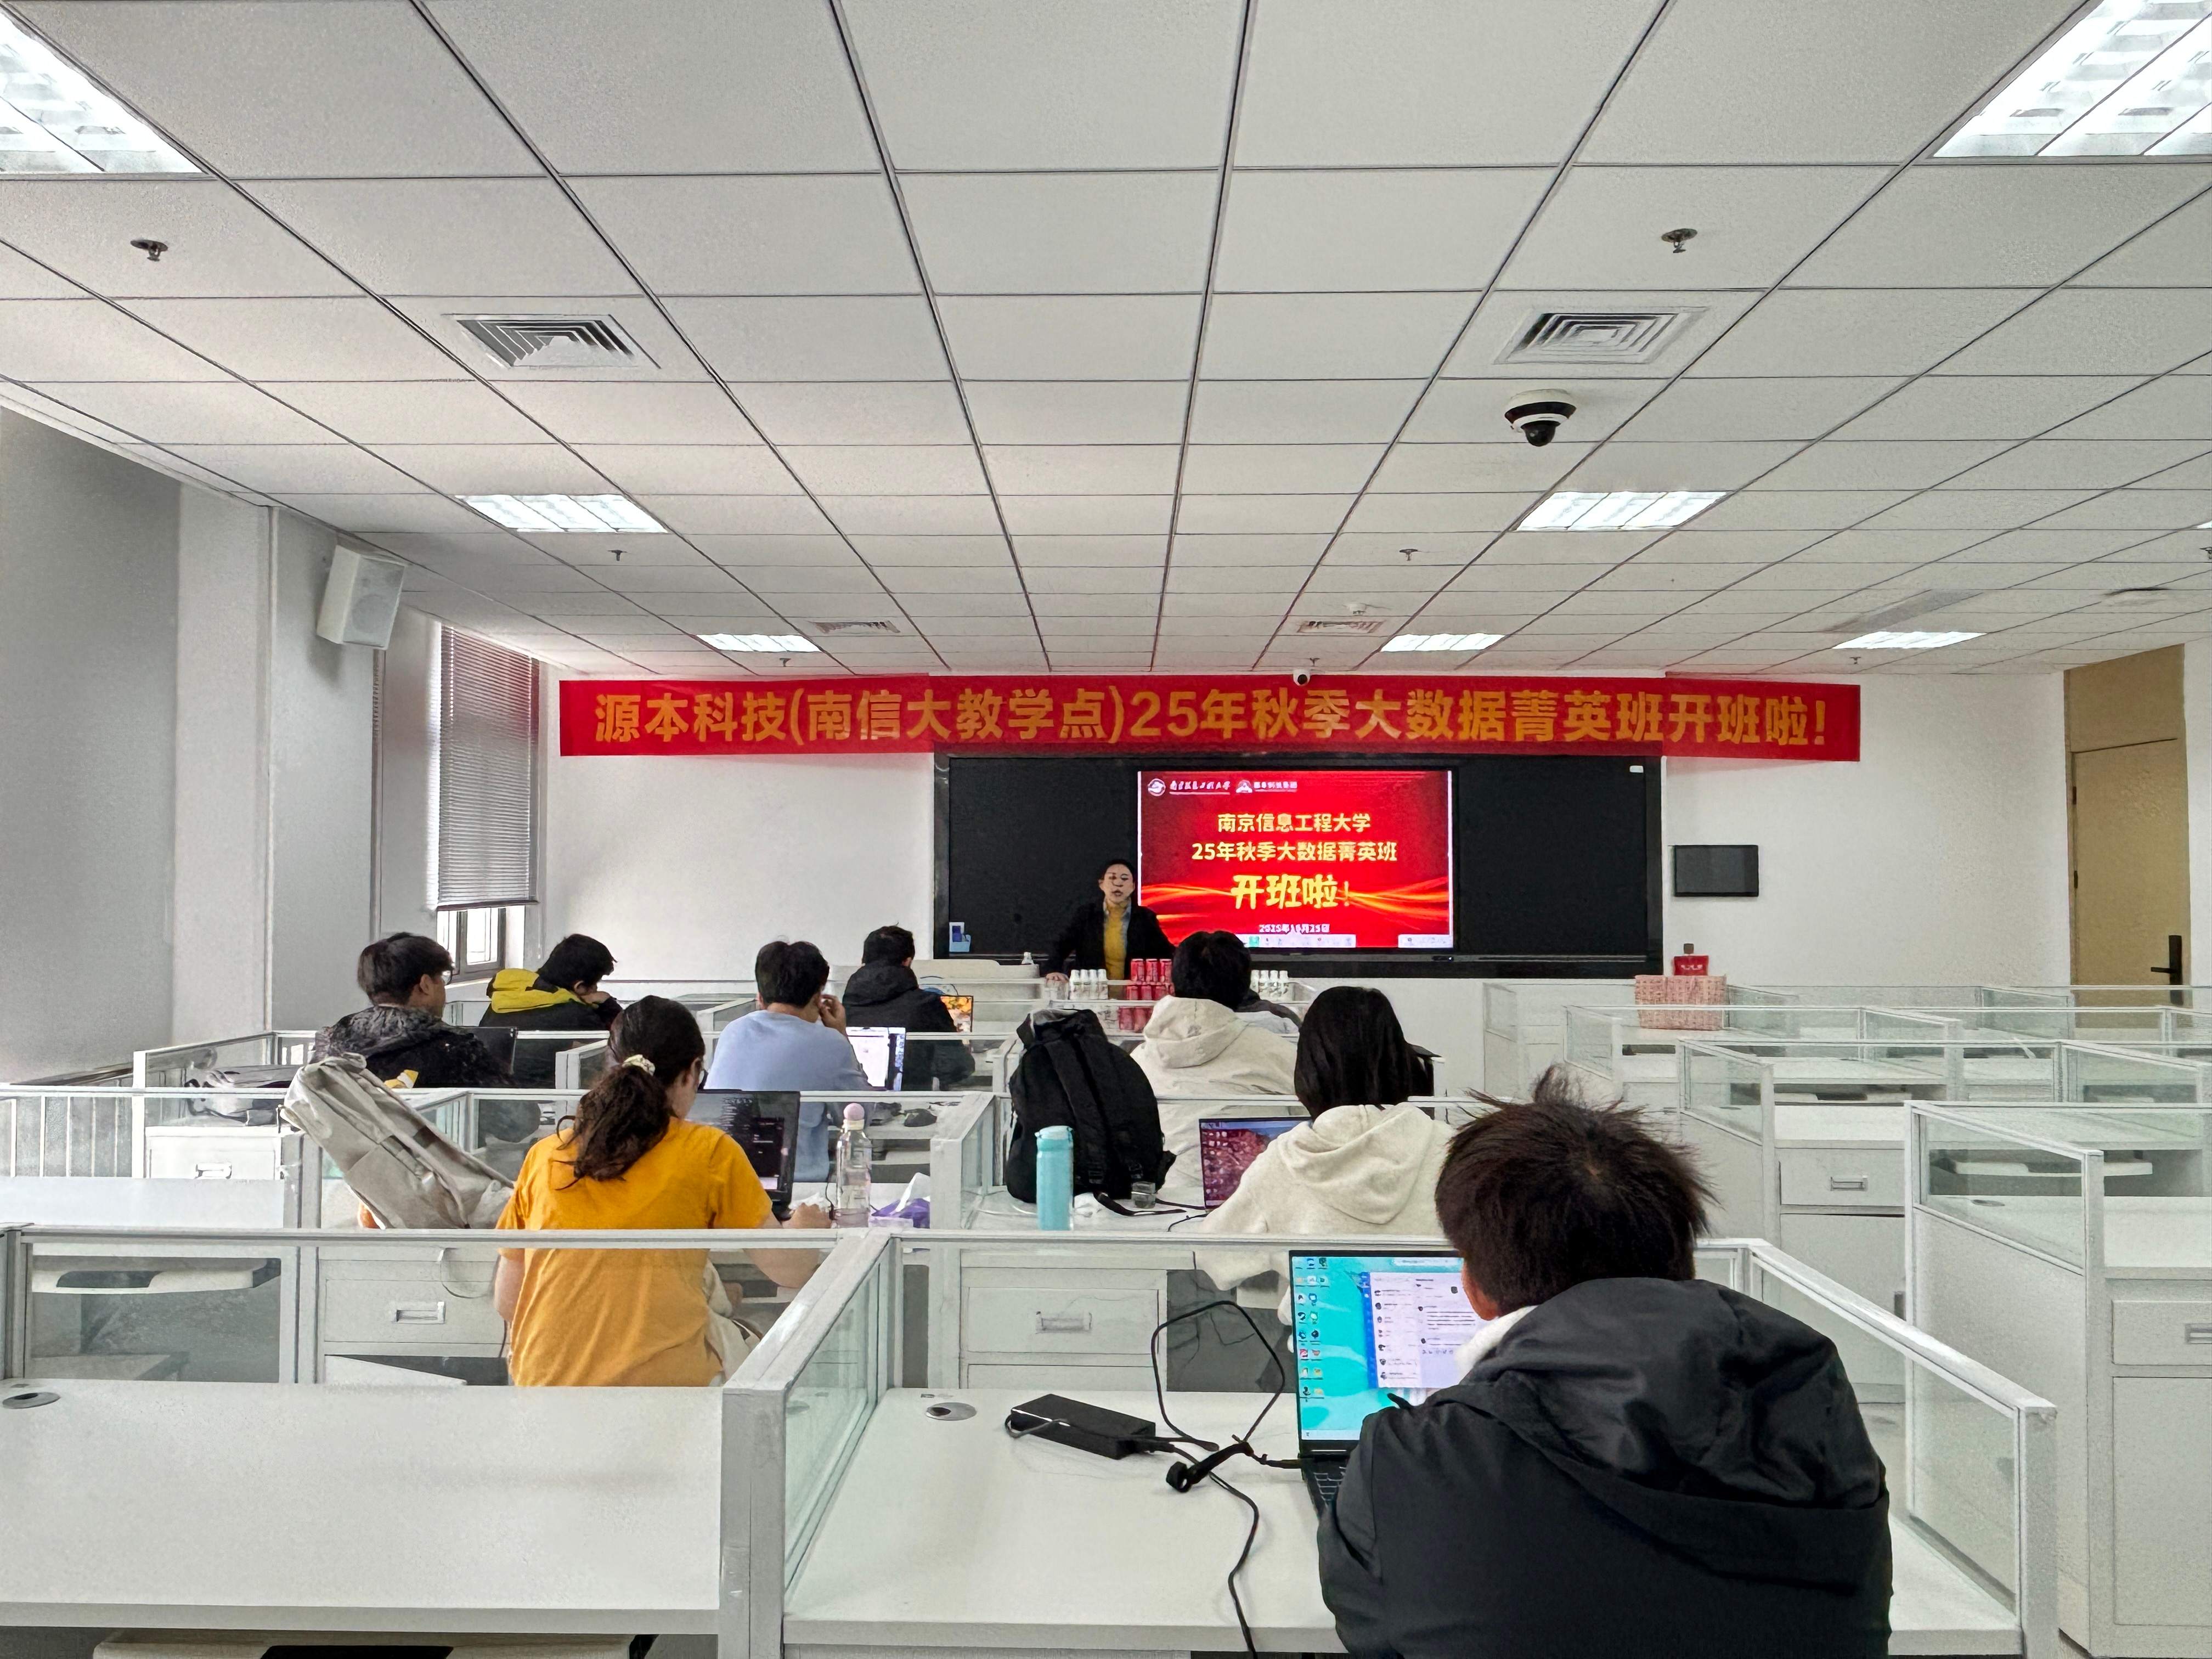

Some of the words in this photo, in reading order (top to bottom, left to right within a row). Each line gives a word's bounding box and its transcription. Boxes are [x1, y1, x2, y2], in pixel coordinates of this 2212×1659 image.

[595, 686, 1825, 746] 源本科技(南信大教学点)25年秋季大数据菁英班开班啦!
[1217, 812, 1371, 833] 南京信息工程大学
[1191, 841, 1397, 862] 25年秋季大数据菁英班
[1231, 873, 1350, 910] 开班啦!
